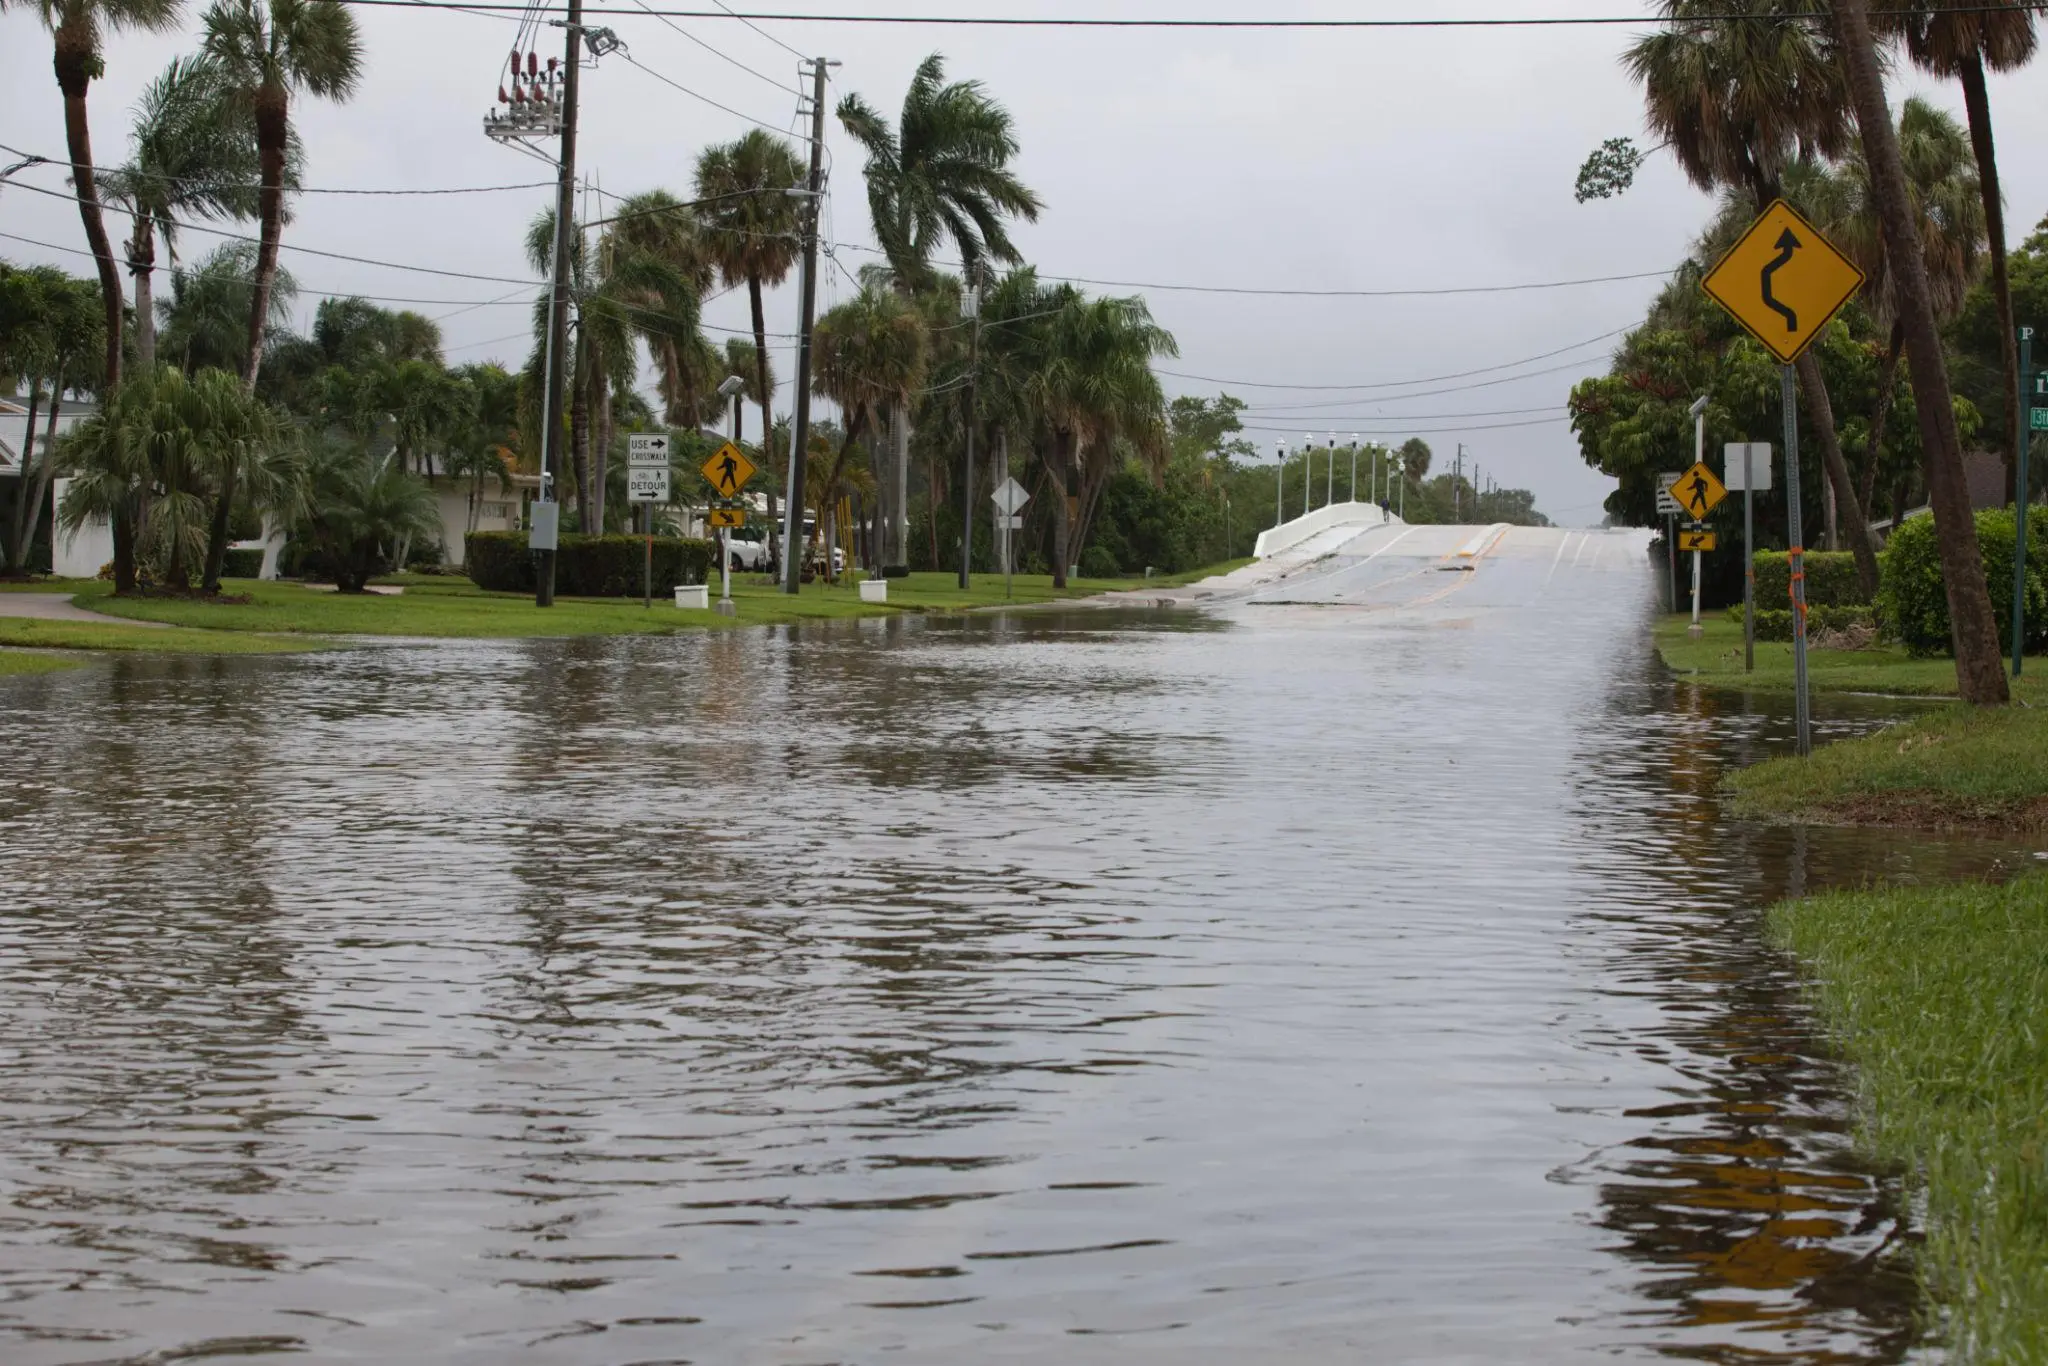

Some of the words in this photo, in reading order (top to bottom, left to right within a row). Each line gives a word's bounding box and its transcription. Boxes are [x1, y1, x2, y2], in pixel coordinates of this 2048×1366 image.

[631, 440, 648, 449] USE
[631, 452, 666, 460] CROSSWALK
[631, 482, 667, 490] DETOUR
